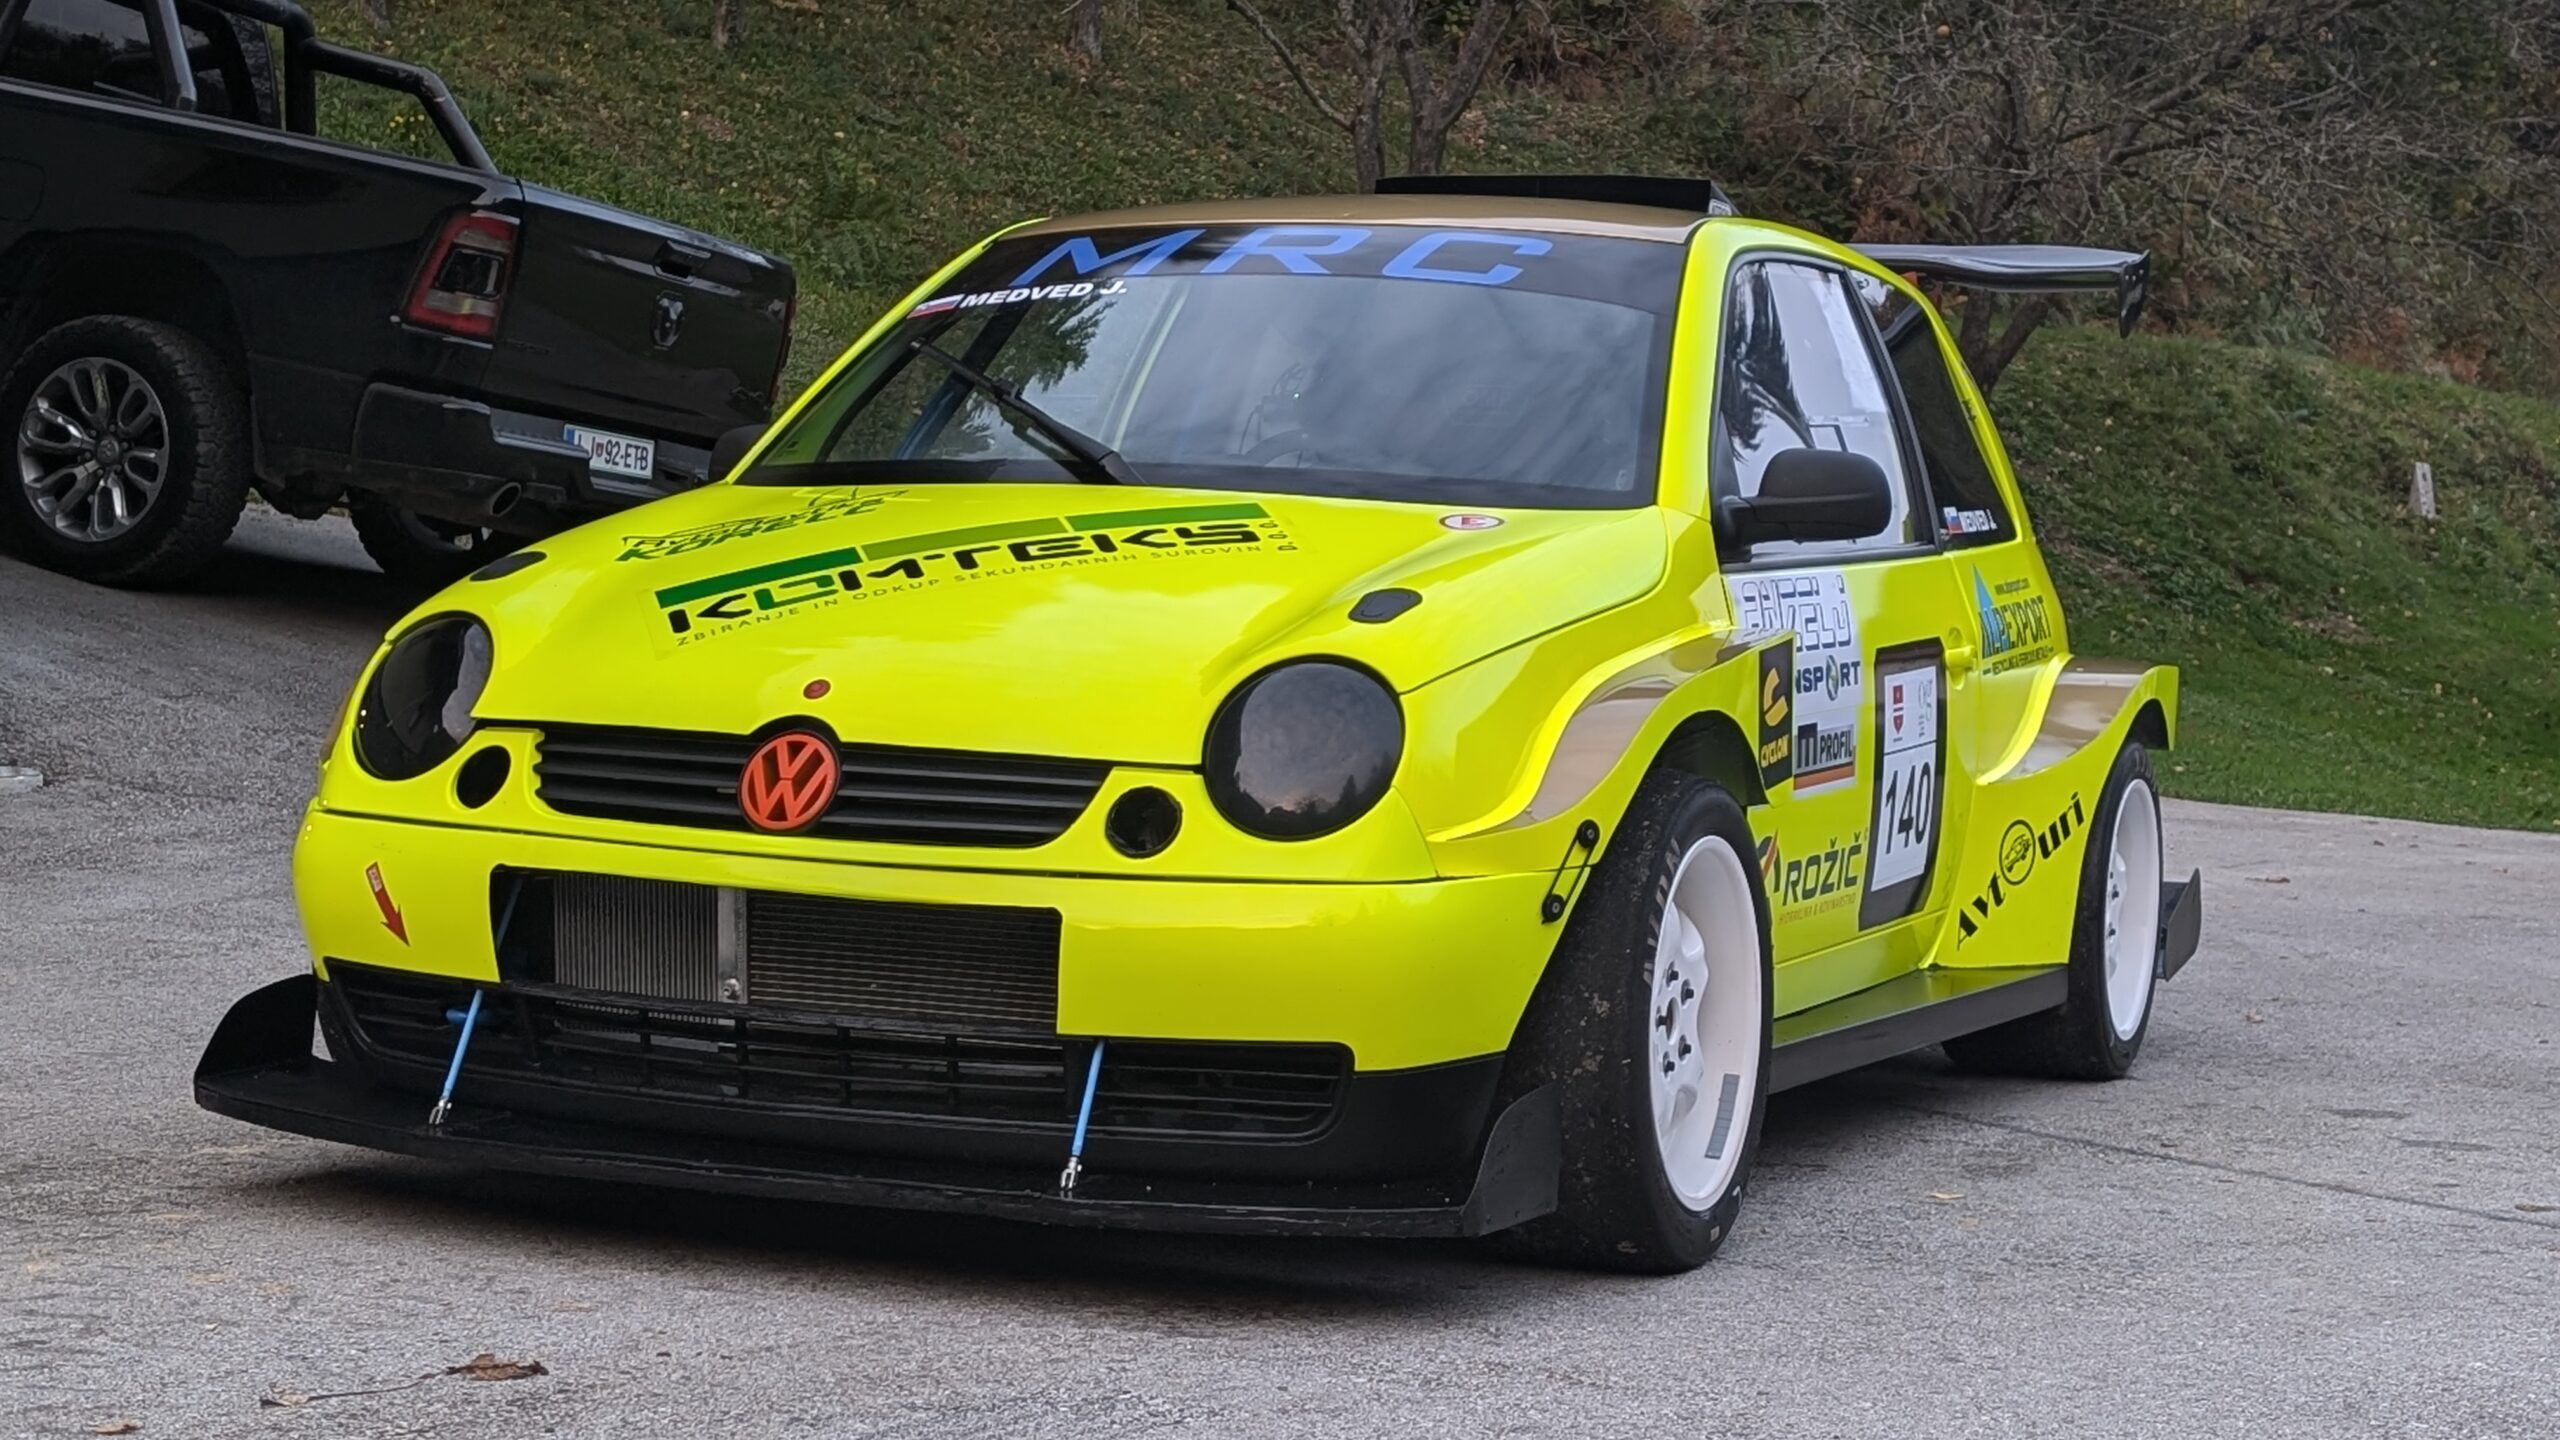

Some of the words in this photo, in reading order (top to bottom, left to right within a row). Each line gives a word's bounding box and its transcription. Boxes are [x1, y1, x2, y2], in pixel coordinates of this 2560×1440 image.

[959, 282, 1094, 309] MEDVED
[1100, 280, 1127, 295] J.
[1010, 226, 1553, 286] MRC
[667, 522, 1262, 634] KOMTEKS
[677, 606, 800, 646] ZBIRANJE
[814, 599, 839, 610] IN
[852, 578, 940, 600] ODKUP
[953, 553, 1138, 583] SEKUNDARNIH
[1150, 545, 1262, 560] SUROVIN
[746, 737, 833, 825] VW
[1820, 730, 1853, 763] PROFIL
[1885, 761, 1931, 855] 140
[1782, 831, 1862, 907] ROŽIČ
